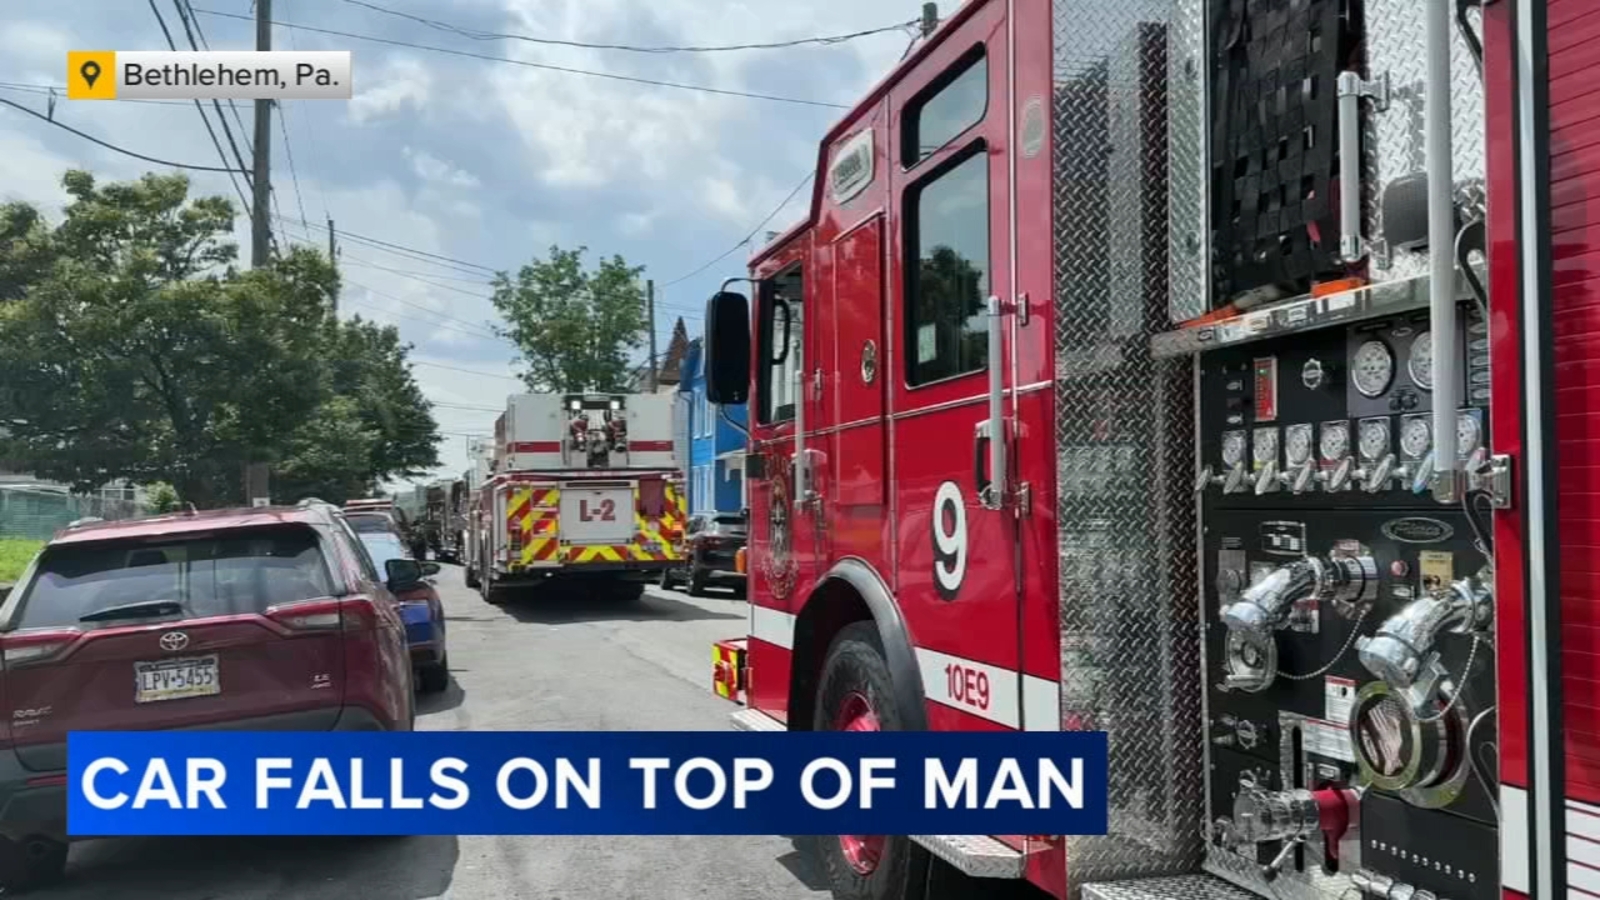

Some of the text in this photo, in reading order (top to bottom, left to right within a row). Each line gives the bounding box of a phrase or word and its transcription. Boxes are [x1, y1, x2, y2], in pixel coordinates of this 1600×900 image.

[579, 498, 616, 522] L-2
[932, 480, 968, 597] 9
[944, 662, 990, 711] 10E9
